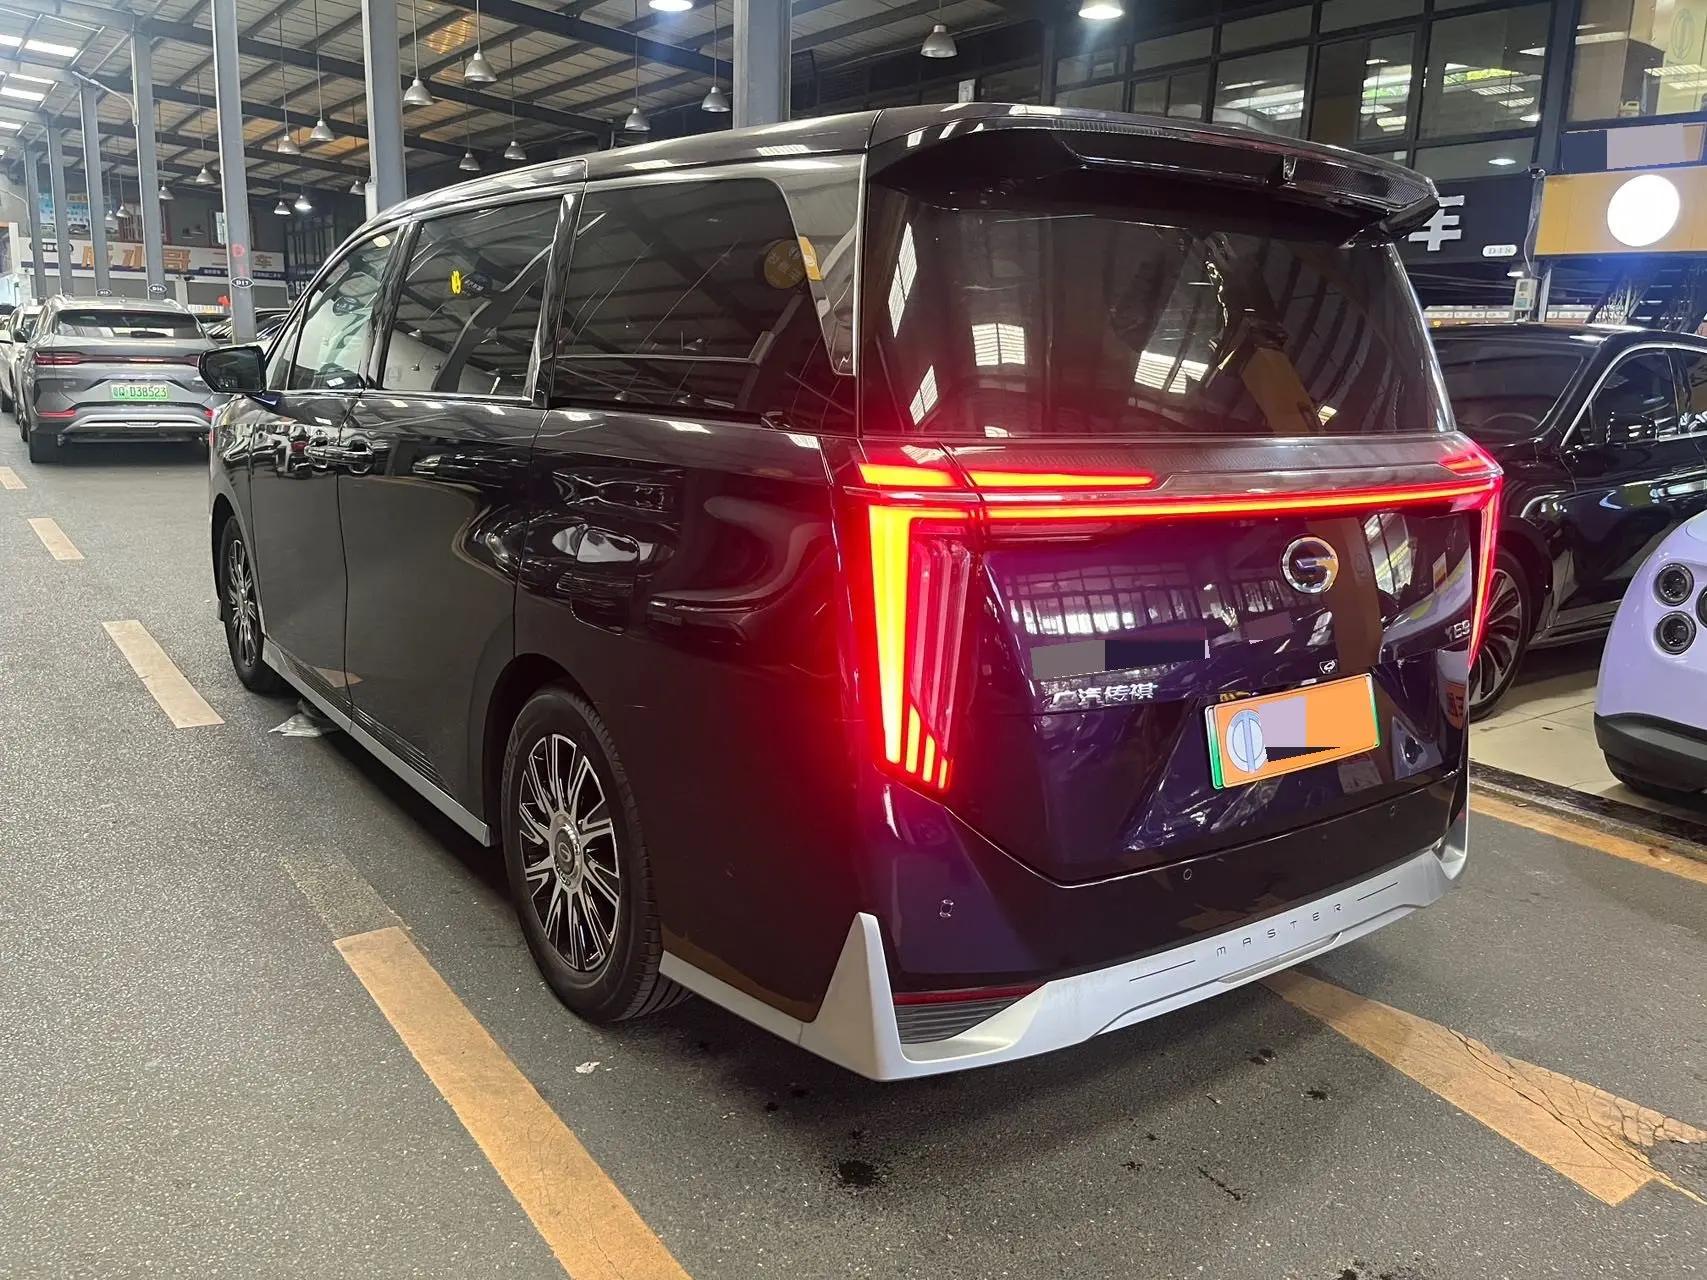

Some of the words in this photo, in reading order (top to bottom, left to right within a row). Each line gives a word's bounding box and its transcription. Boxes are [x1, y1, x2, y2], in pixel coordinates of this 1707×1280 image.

[1408, 195, 1465, 251] 车
[1048, 682, 1158, 708] 广汽传祺
[1215, 903, 1342, 957] MASTER
